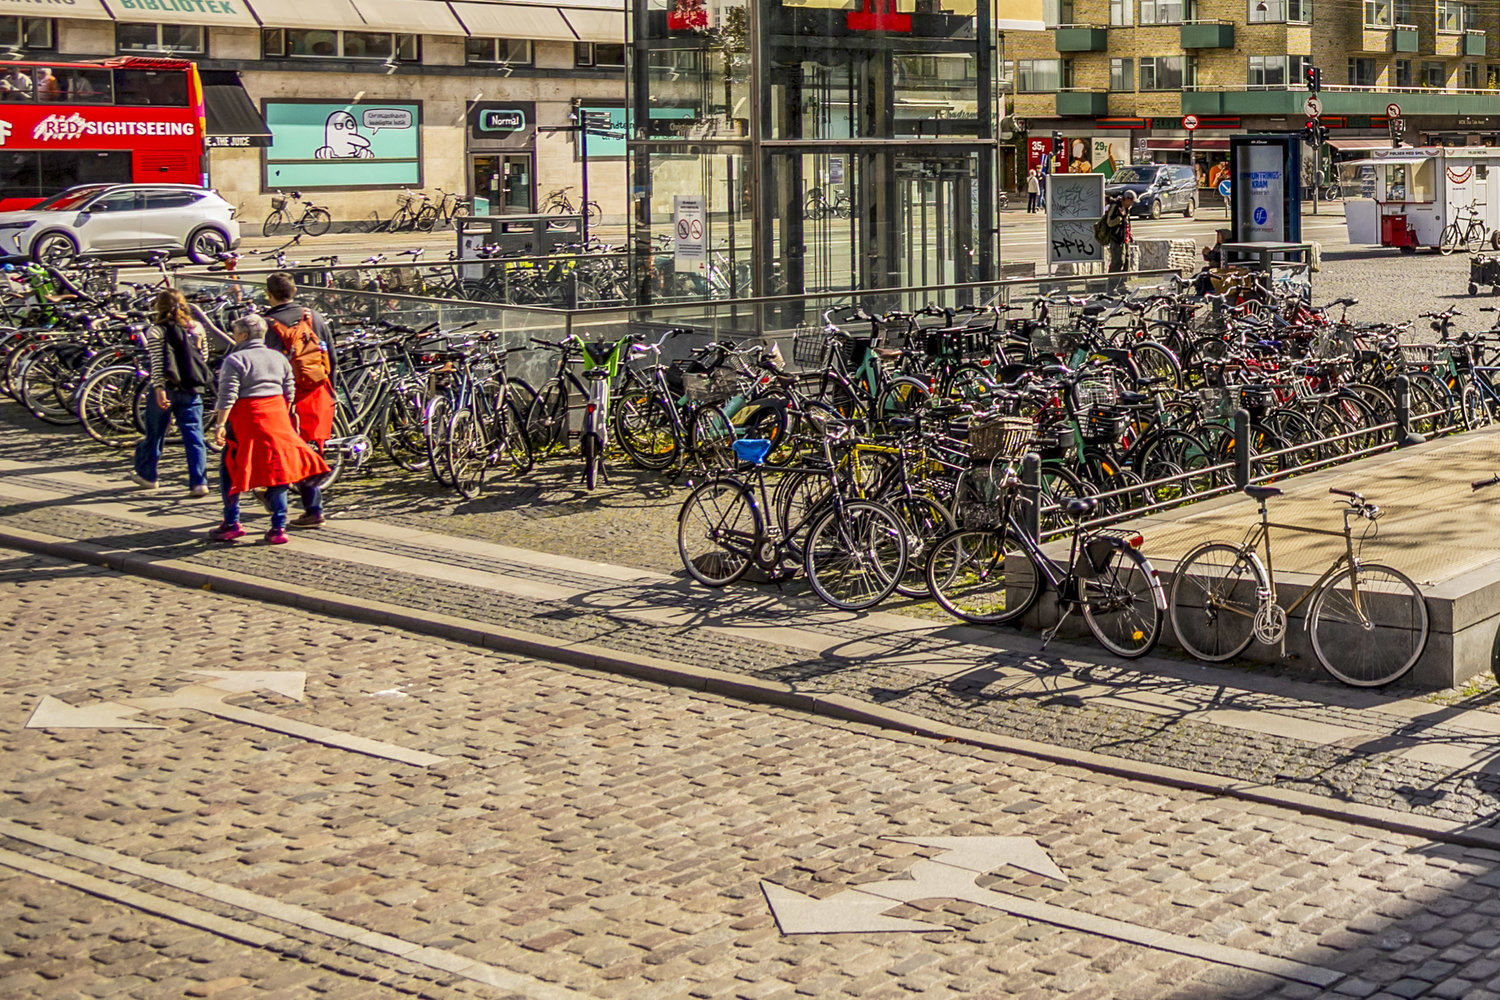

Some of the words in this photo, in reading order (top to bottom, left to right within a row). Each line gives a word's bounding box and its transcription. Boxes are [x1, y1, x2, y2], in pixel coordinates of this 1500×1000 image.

[491, 115, 520, 126] Normal
[46, 120, 79, 134] RED
[86, 120, 194, 136] SIGHTSEEING
